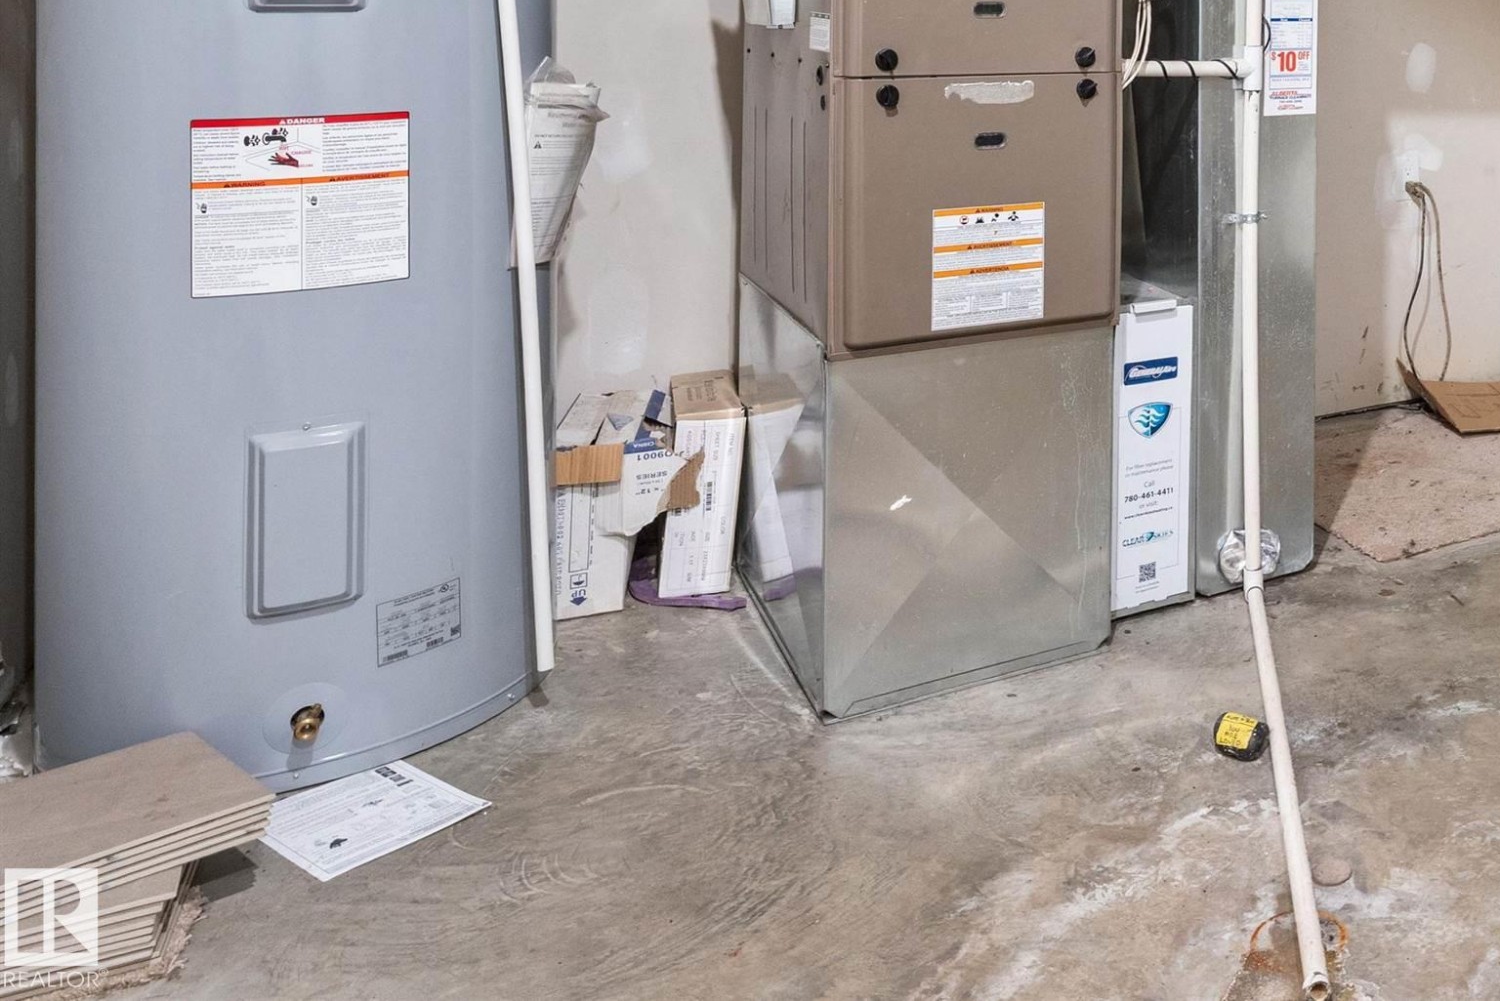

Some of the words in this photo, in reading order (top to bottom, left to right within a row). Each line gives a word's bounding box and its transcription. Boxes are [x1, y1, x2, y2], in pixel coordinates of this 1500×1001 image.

[1297, 51, 1311, 61] OFF
[286, 117, 326, 125] DANGER
[635, 470, 668, 481] SERIES
[1143, 480, 1155, 488] Call
[1124, 487, 1174, 504] 780-461-4411
